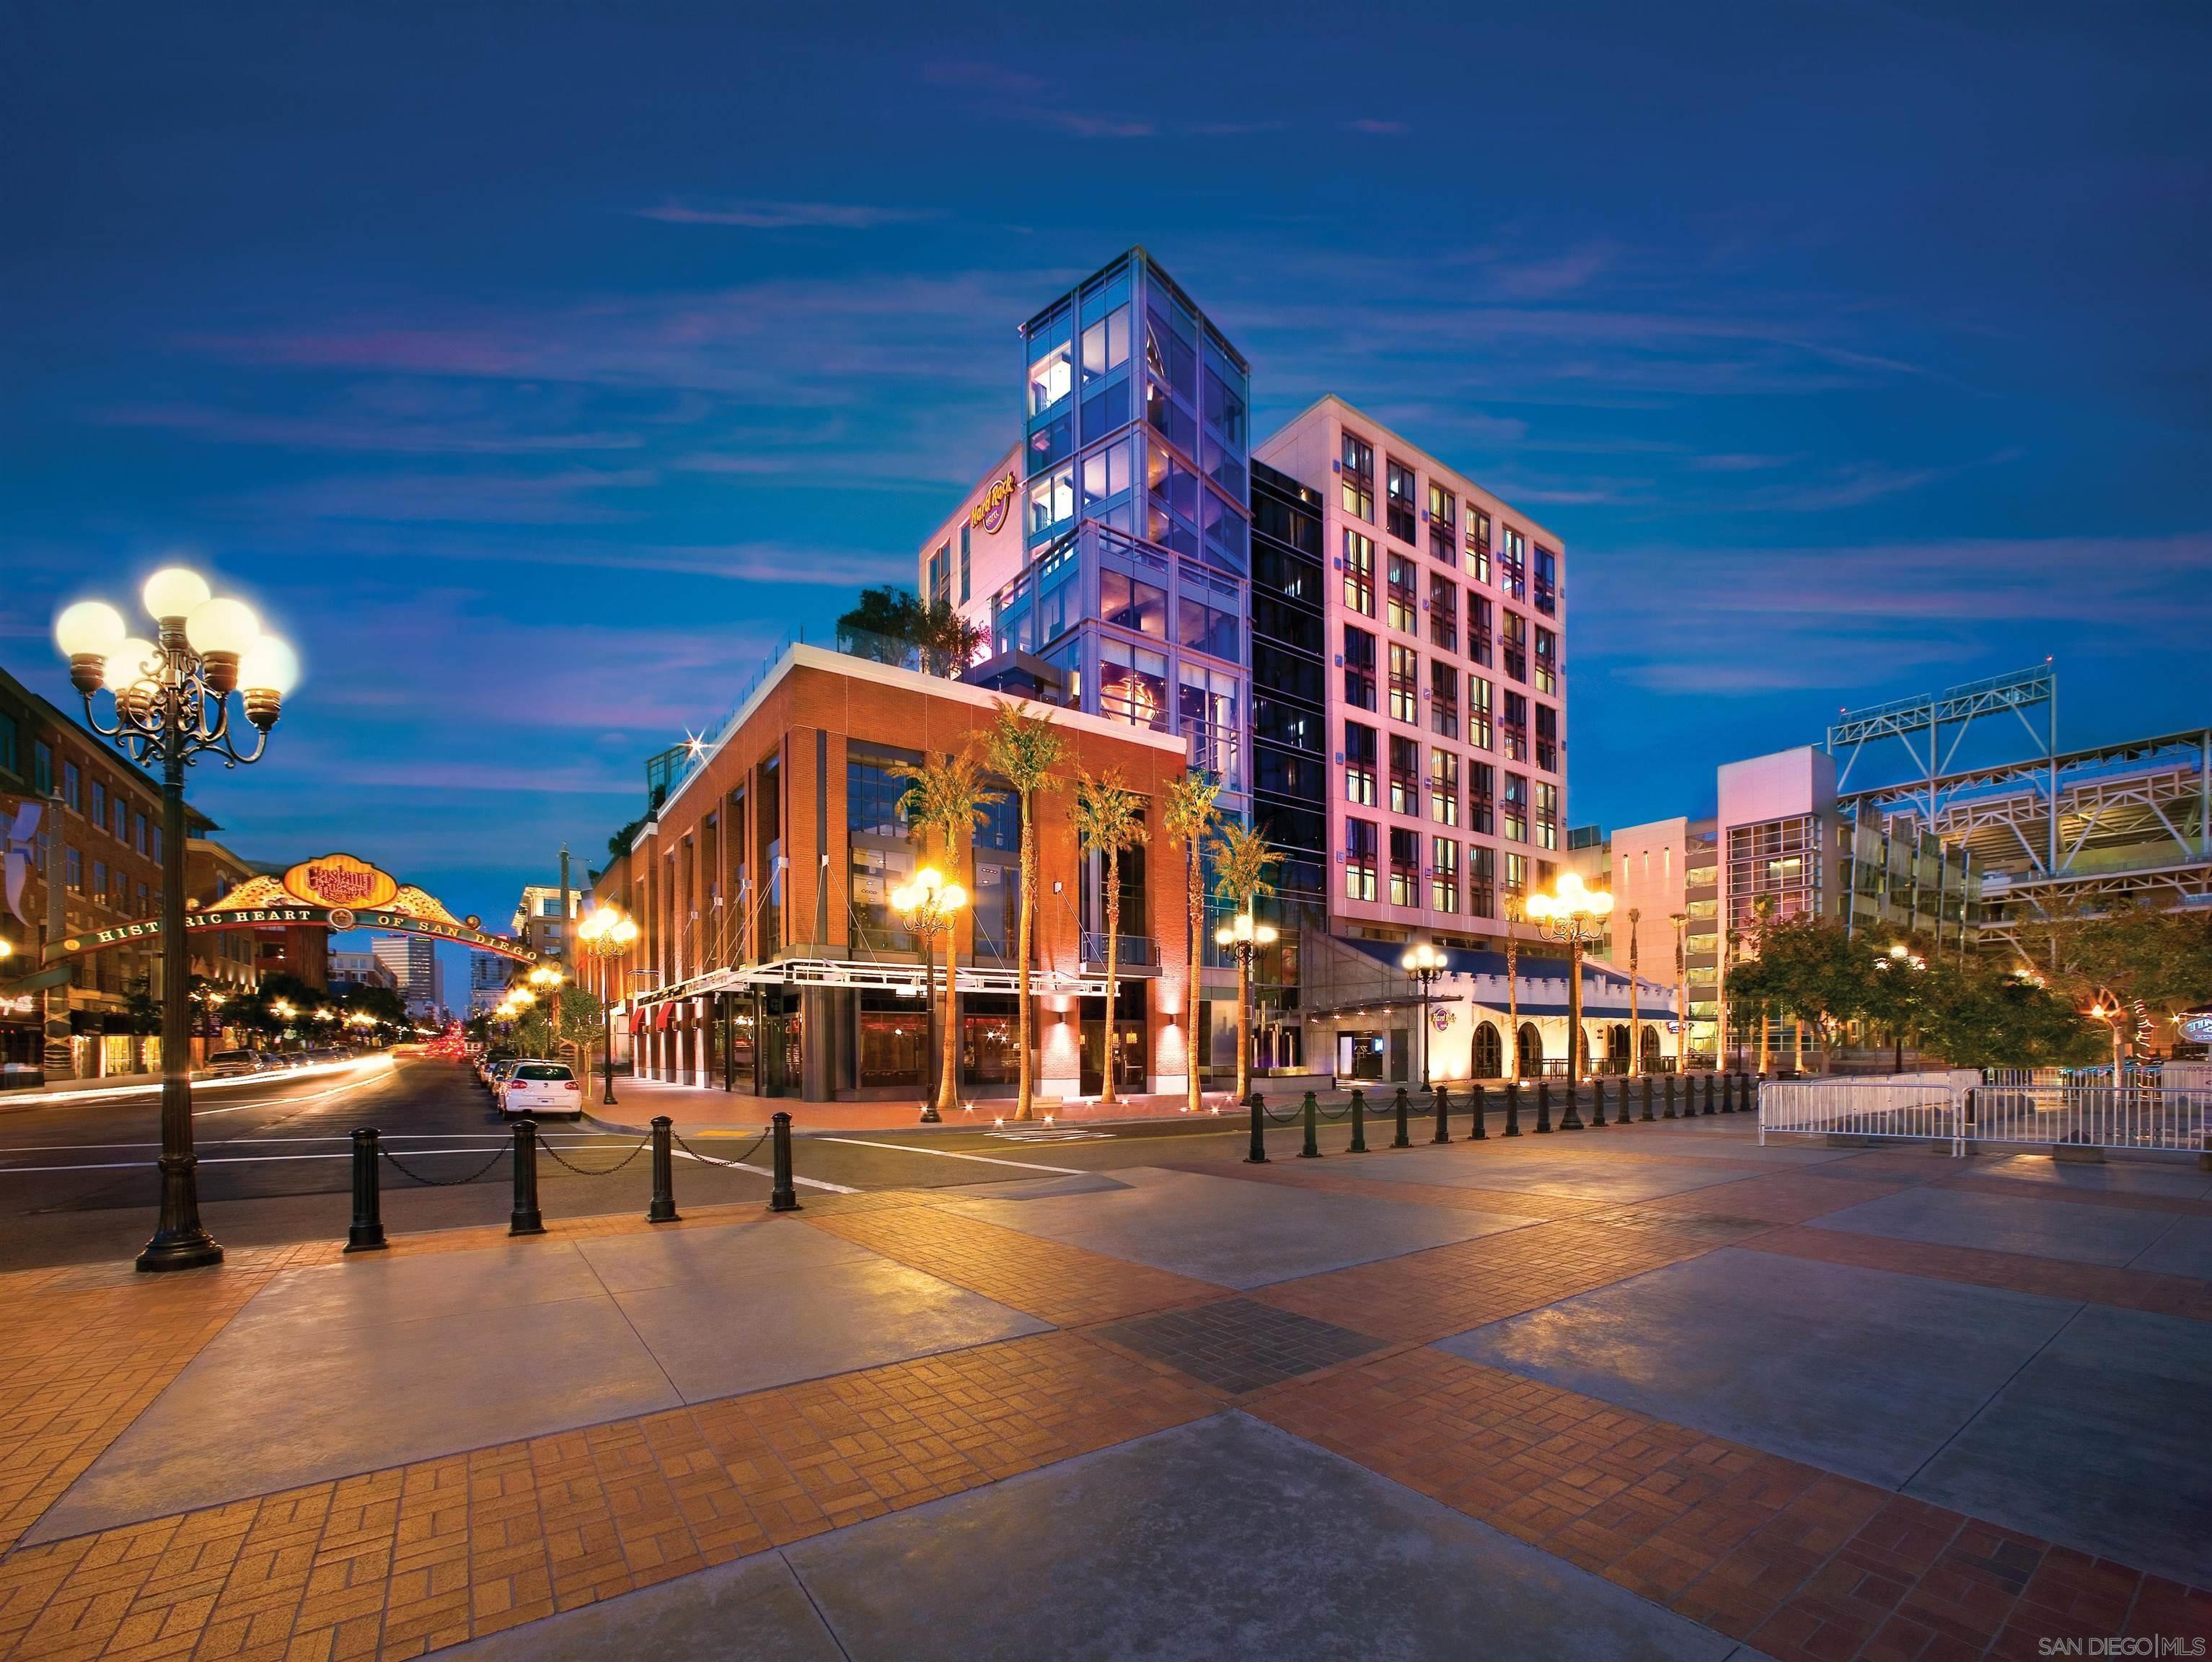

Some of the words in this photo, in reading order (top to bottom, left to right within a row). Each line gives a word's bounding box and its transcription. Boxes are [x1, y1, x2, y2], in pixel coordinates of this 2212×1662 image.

[97, 913, 221, 943] HISTRIC
[235, 910, 310, 923] HEART
[378, 915, 404, 927] OF
[418, 921, 460, 937] SAN
[474, 933, 537, 961] DIEGO
